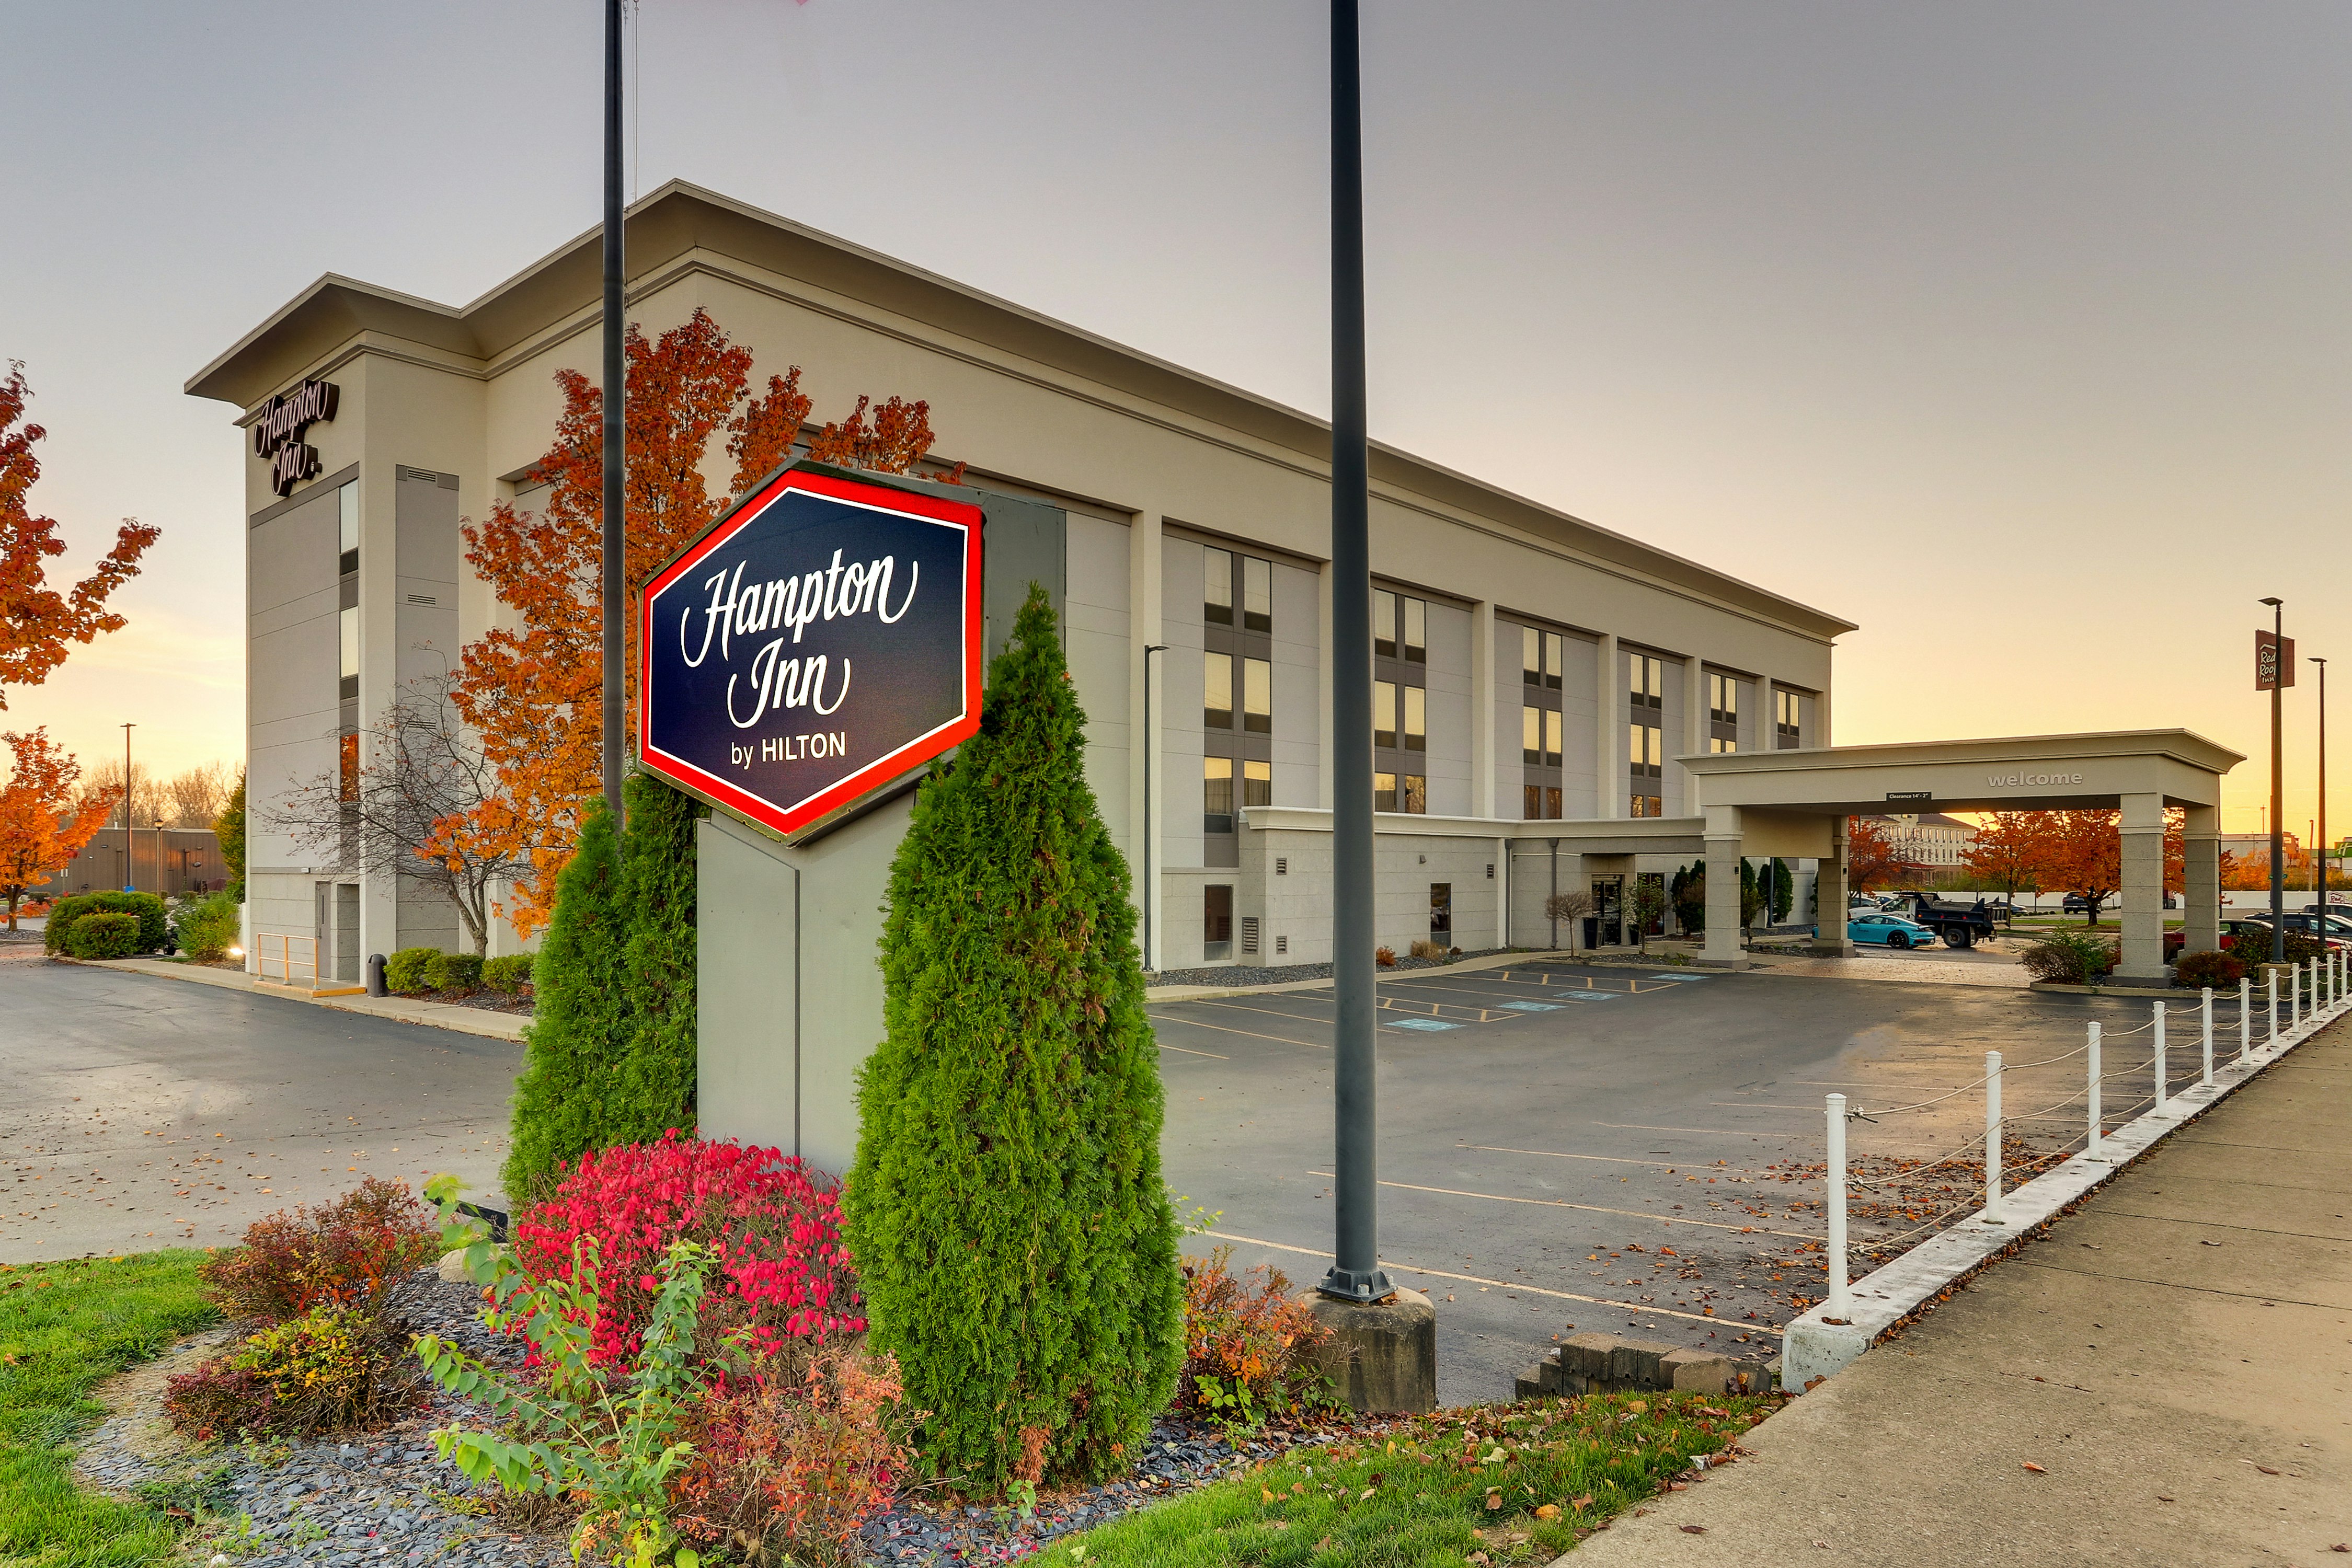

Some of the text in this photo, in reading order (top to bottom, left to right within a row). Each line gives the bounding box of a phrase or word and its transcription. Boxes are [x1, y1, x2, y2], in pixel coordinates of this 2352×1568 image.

[254, 380, 329, 457] Hampton
[272, 442, 308, 495] Inn
[681, 548, 917, 667] Hampton
[727, 637, 851, 728] Inn
[2261, 652, 2276, 663] Red
[731, 732, 846, 770] by HILTON
[1988, 771, 2083, 787] welcome
